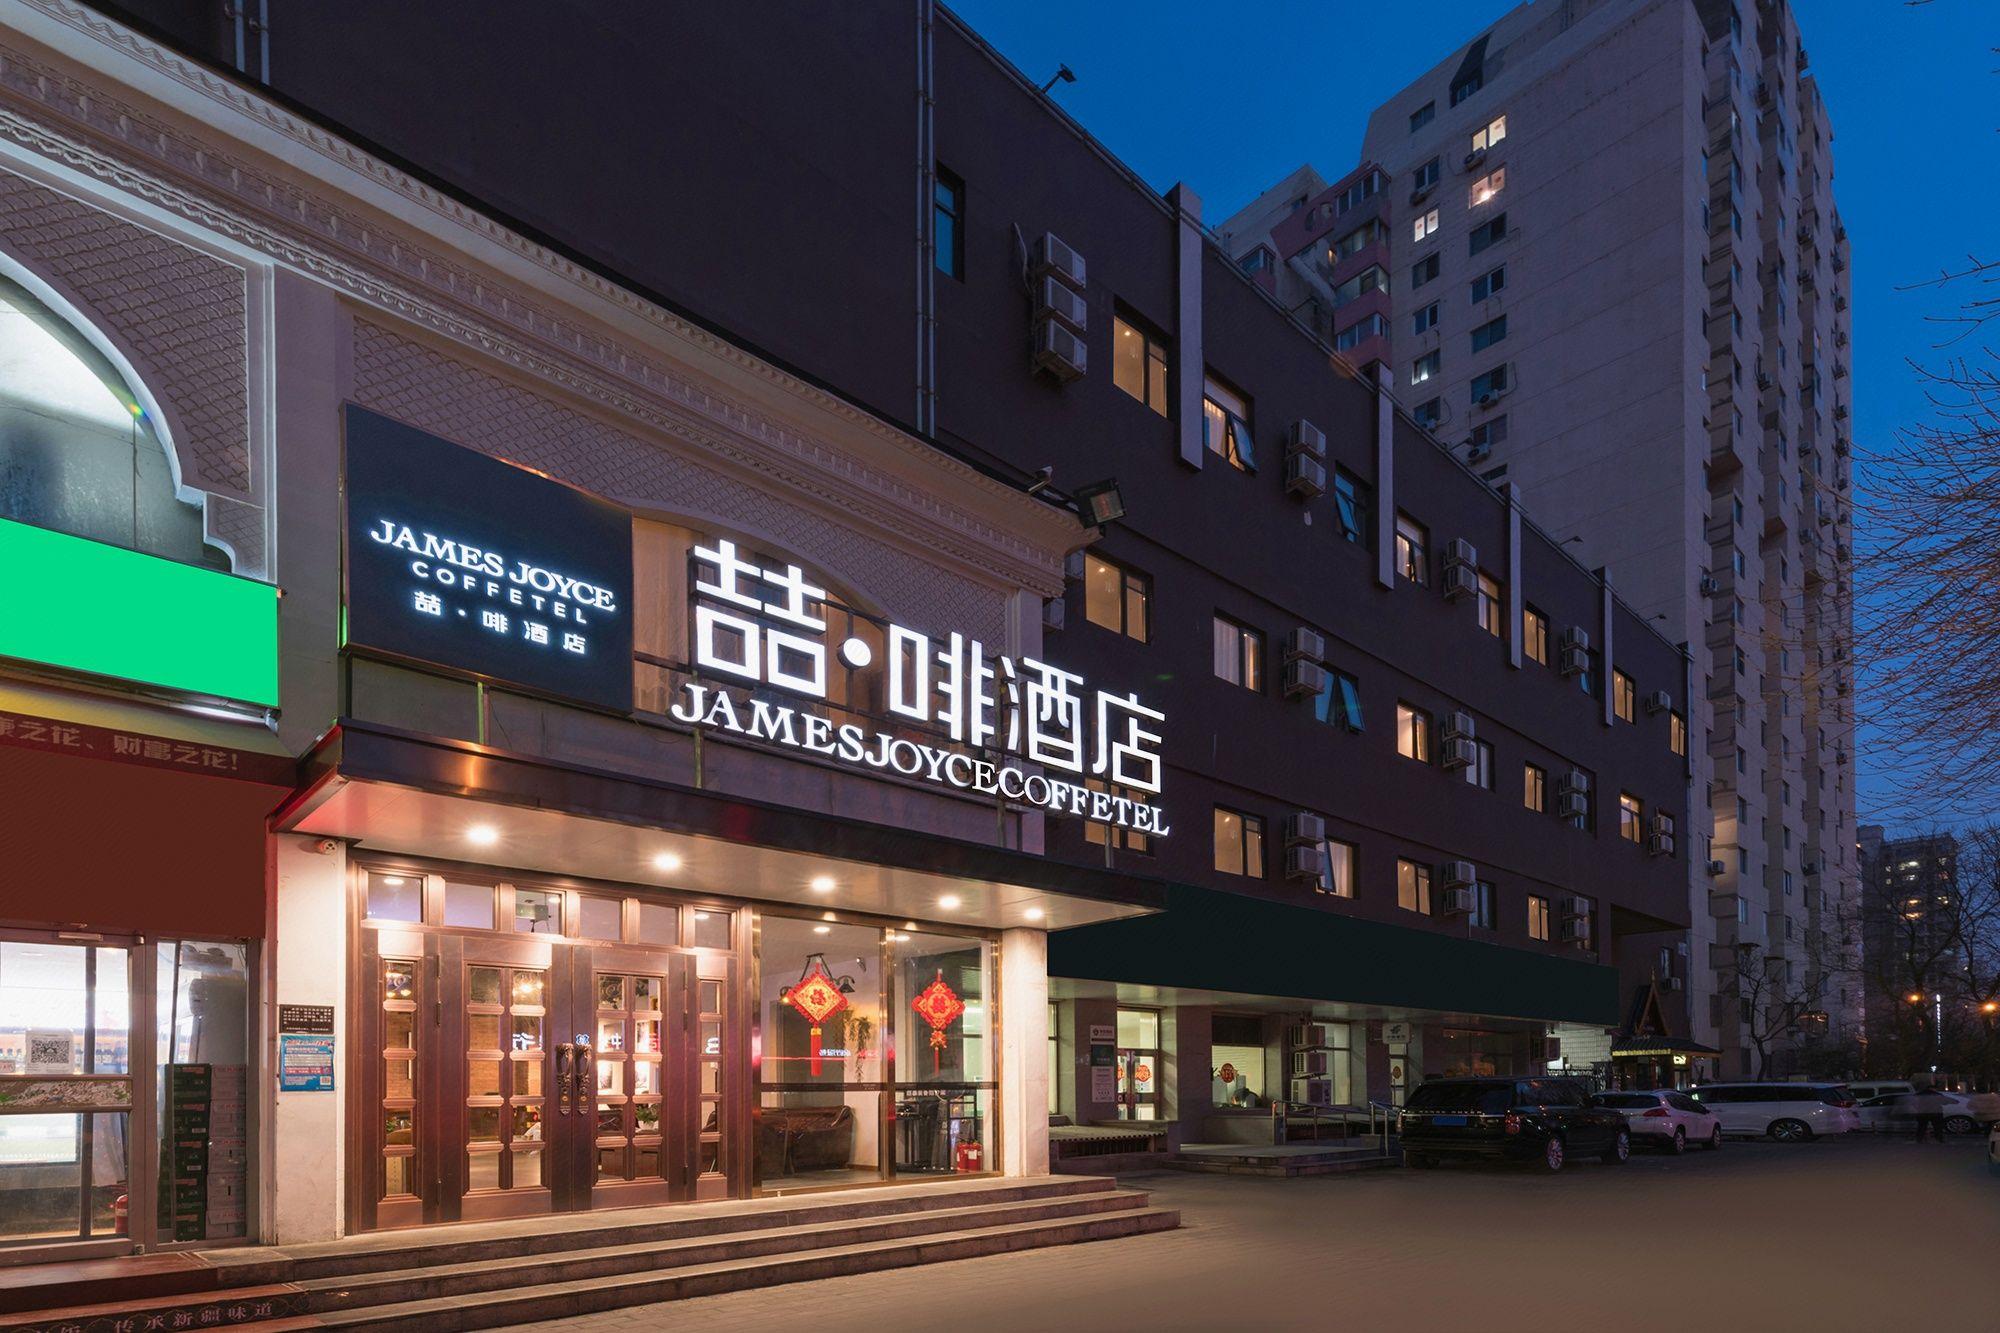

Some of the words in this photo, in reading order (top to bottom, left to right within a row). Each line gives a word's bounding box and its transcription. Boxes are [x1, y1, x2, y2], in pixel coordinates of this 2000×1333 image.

[370, 519, 504, 578] JAMES
[508, 561, 616, 612] JOYCE
[411, 560, 588, 625] COFFETEL
